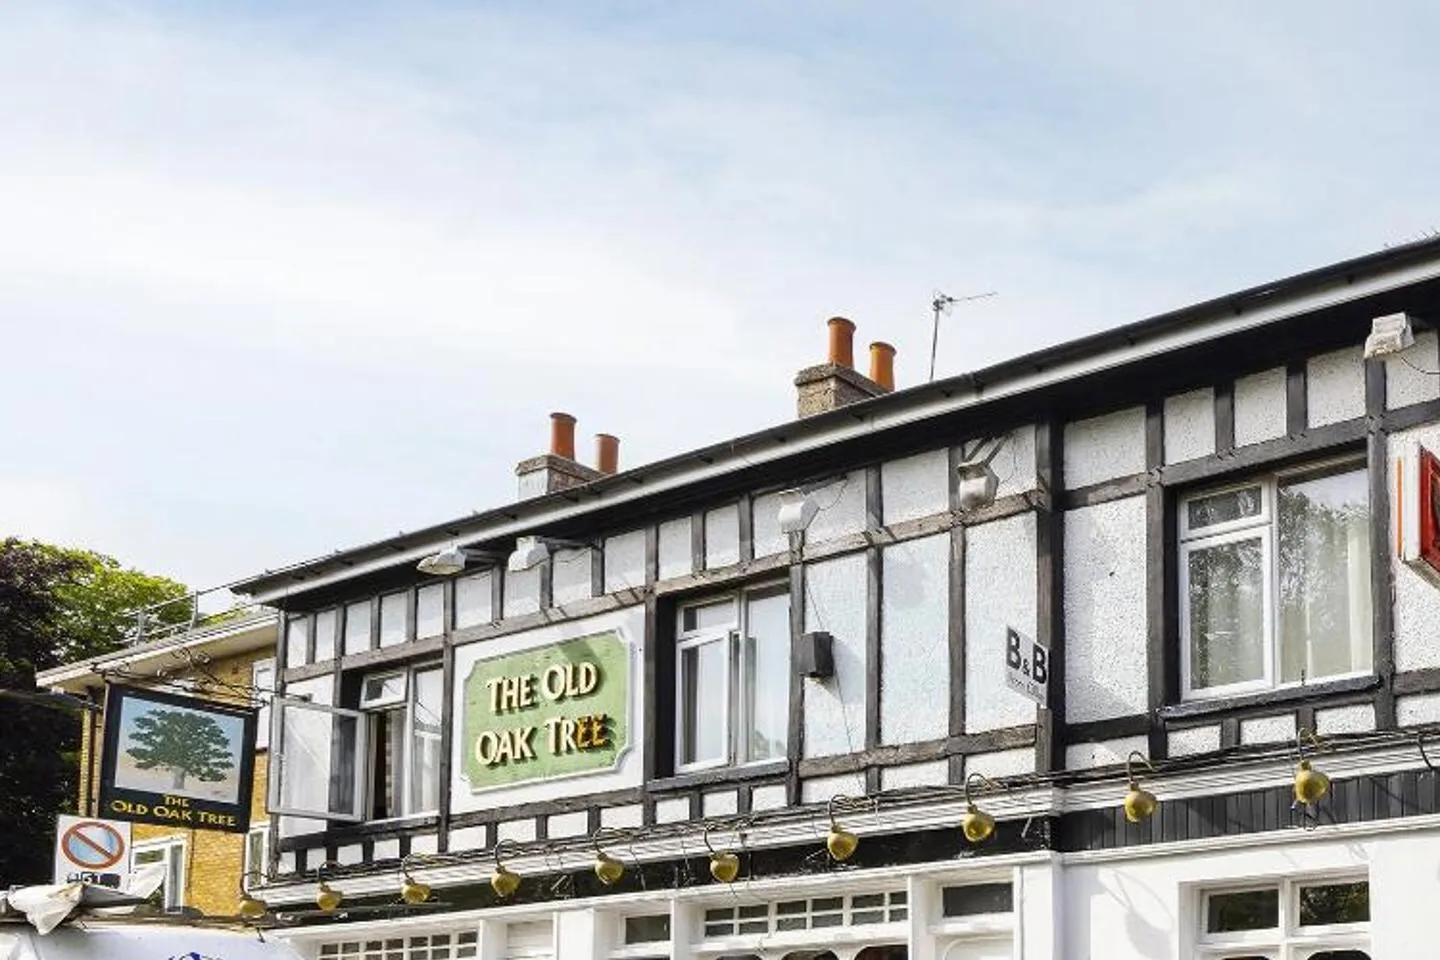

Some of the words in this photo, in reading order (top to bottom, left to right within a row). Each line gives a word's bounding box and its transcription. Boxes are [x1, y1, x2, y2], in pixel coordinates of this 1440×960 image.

[486, 672, 538, 713] THE
[541, 661, 598, 702] OLD
[475, 726, 536, 767] OAK
[545, 713, 611, 756] TREE
[110, 799, 149, 816] OLD
[152, 804, 193, 822] OAK
[197, 810, 238, 827] TREE
[164, 794, 190, 808] THE
